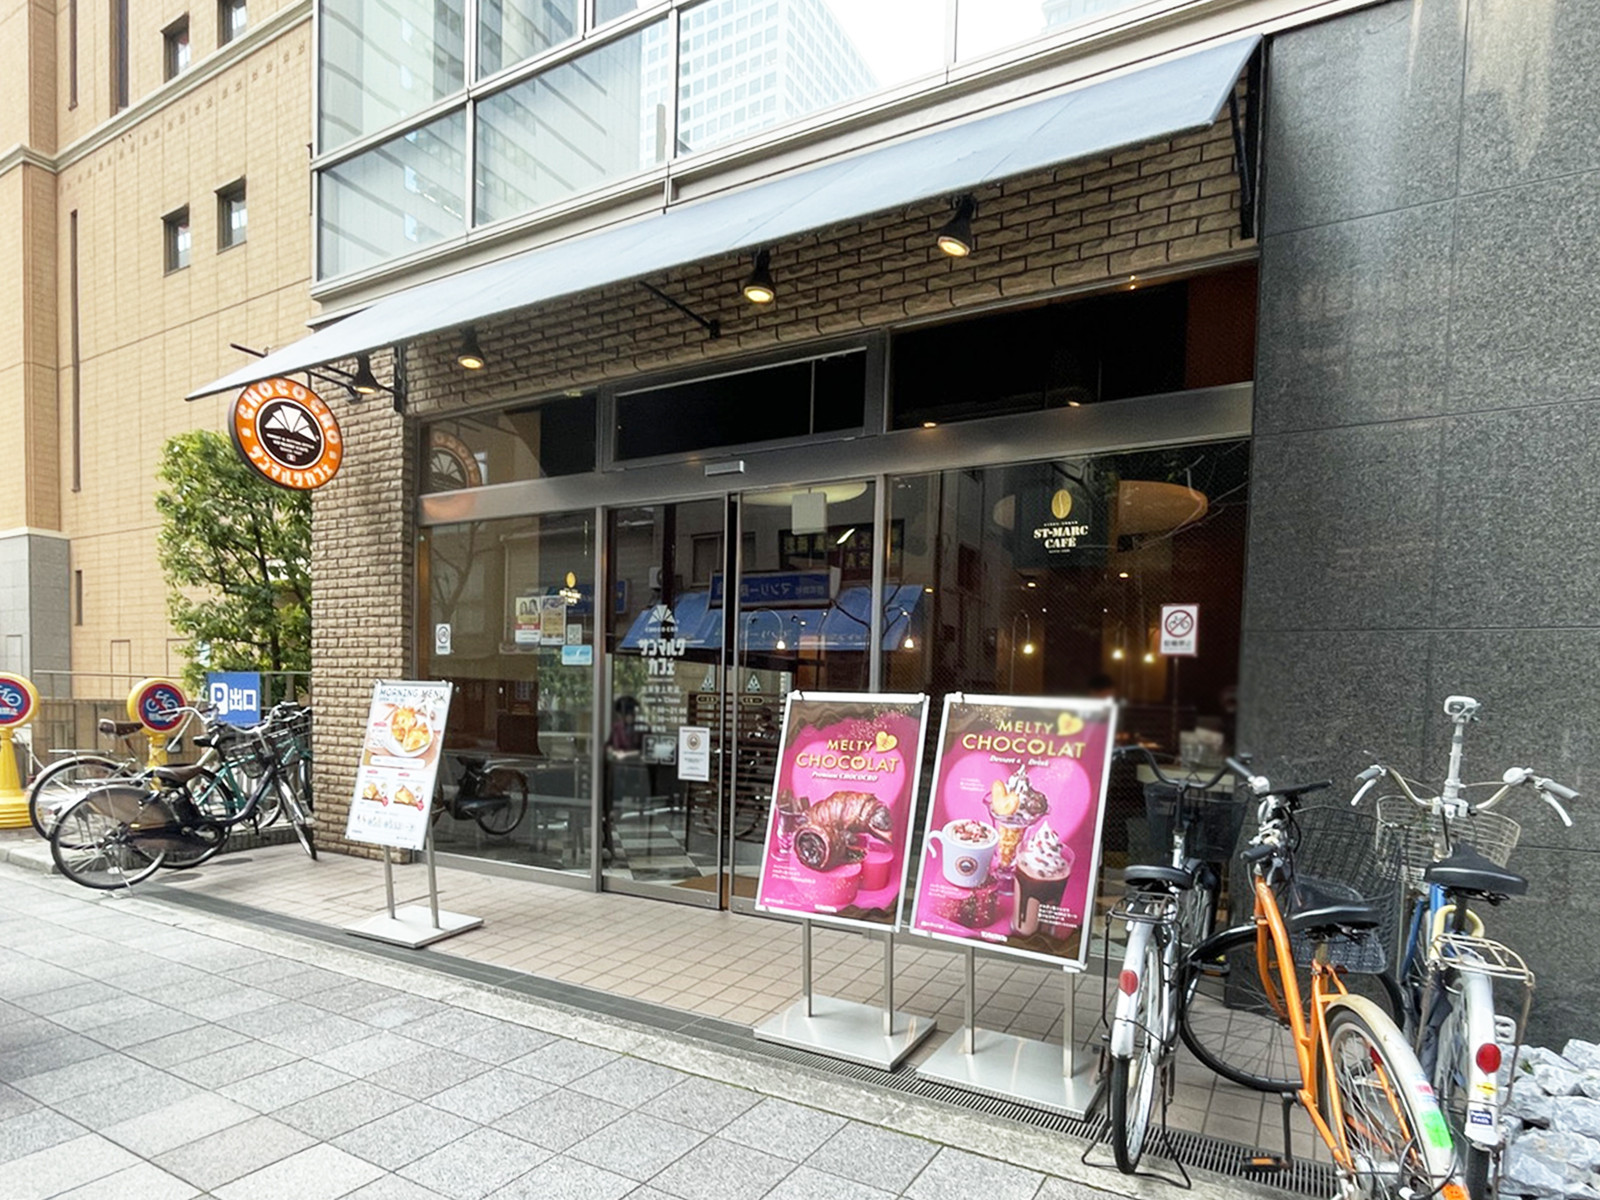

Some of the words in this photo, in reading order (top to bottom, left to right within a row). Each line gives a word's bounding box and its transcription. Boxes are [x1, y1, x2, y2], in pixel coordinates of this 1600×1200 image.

[238, 380, 307, 420] CHOCO
[310, 399, 340, 443] CRO
[637, 638, 686, 656] サンマルク
[647, 657, 676, 675] カフェ
[997, 719, 1055, 734] MELTY
[827, 739, 873, 752] MELTY
[962, 733, 1086, 758] CHOCOLAT
[796, 752, 899, 773] CHOCOLAT
